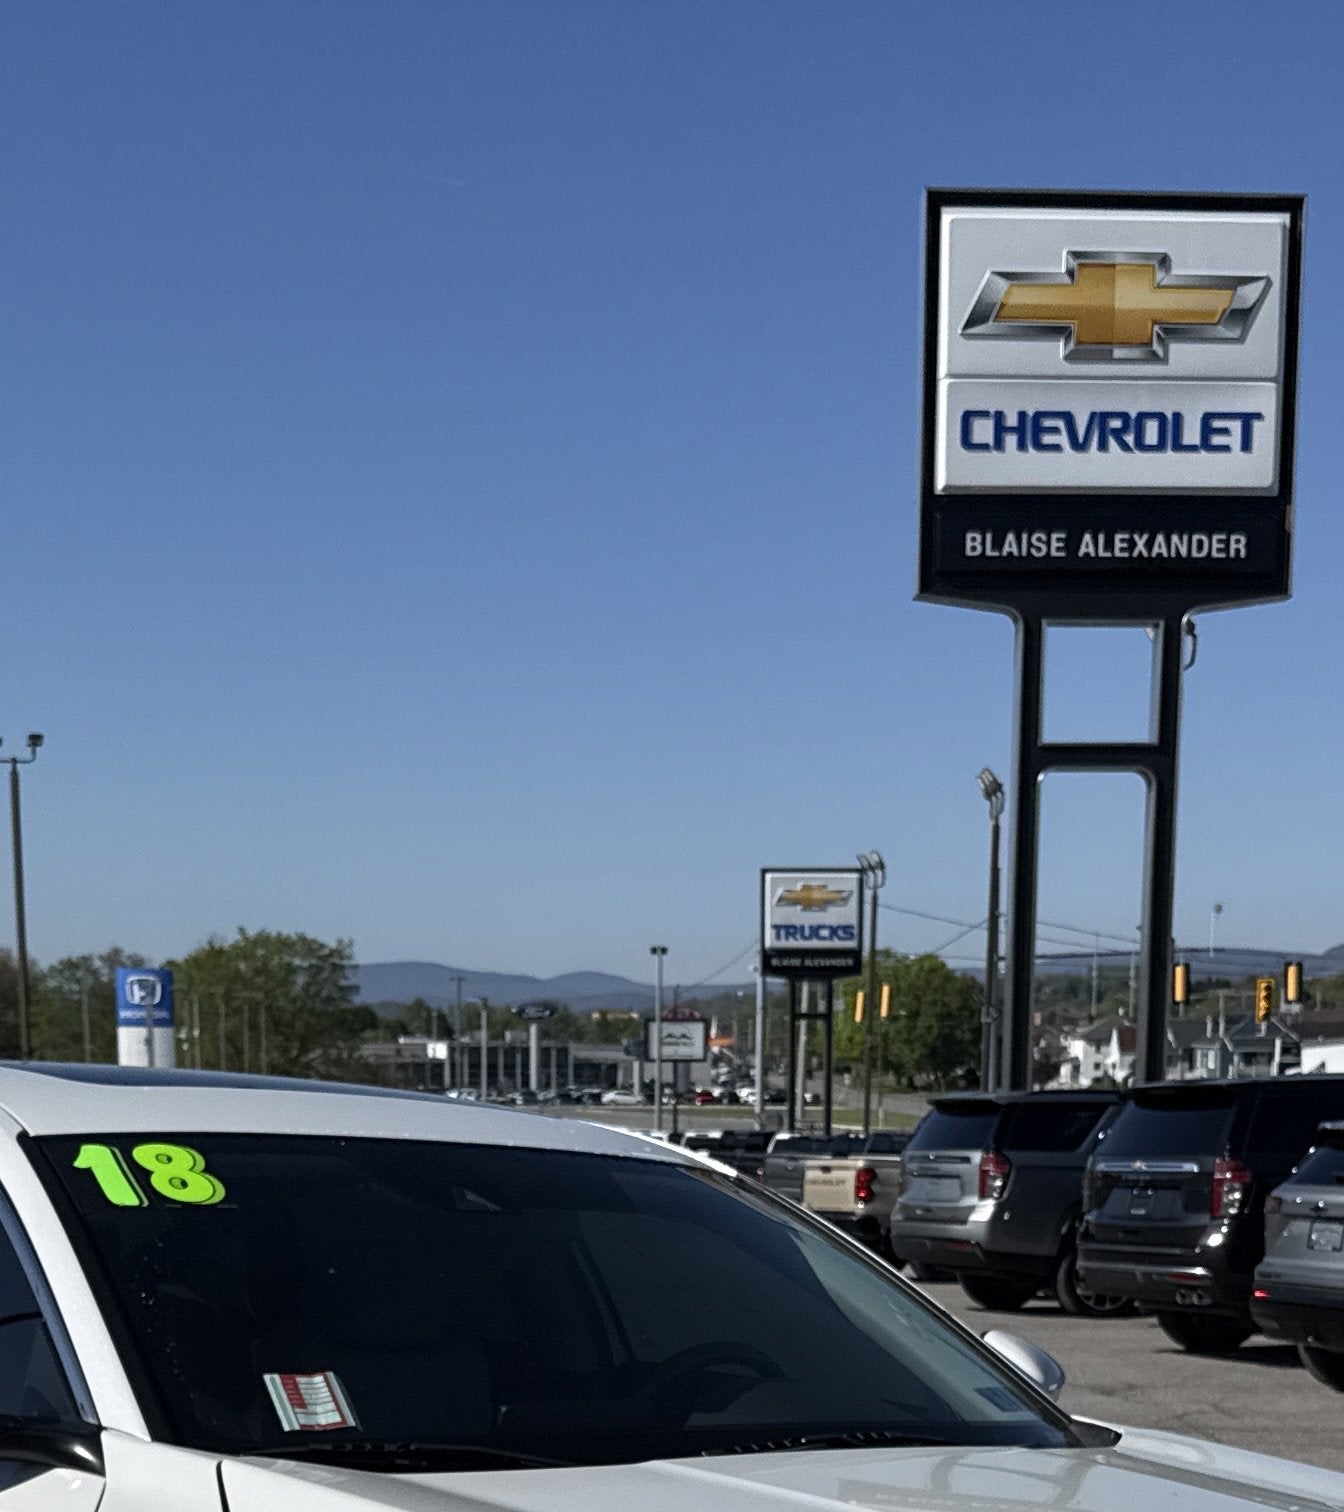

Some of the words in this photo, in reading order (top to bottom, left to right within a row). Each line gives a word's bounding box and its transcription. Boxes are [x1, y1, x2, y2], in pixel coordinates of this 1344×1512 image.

[960, 410, 1265, 453] CHEVROLET
[965, 531, 1067, 557] BLAISE
[1078, 532, 1247, 559] ALEXANDER
[772, 924, 855, 941] TRUCKS
[73, 1144, 226, 1207] 18
